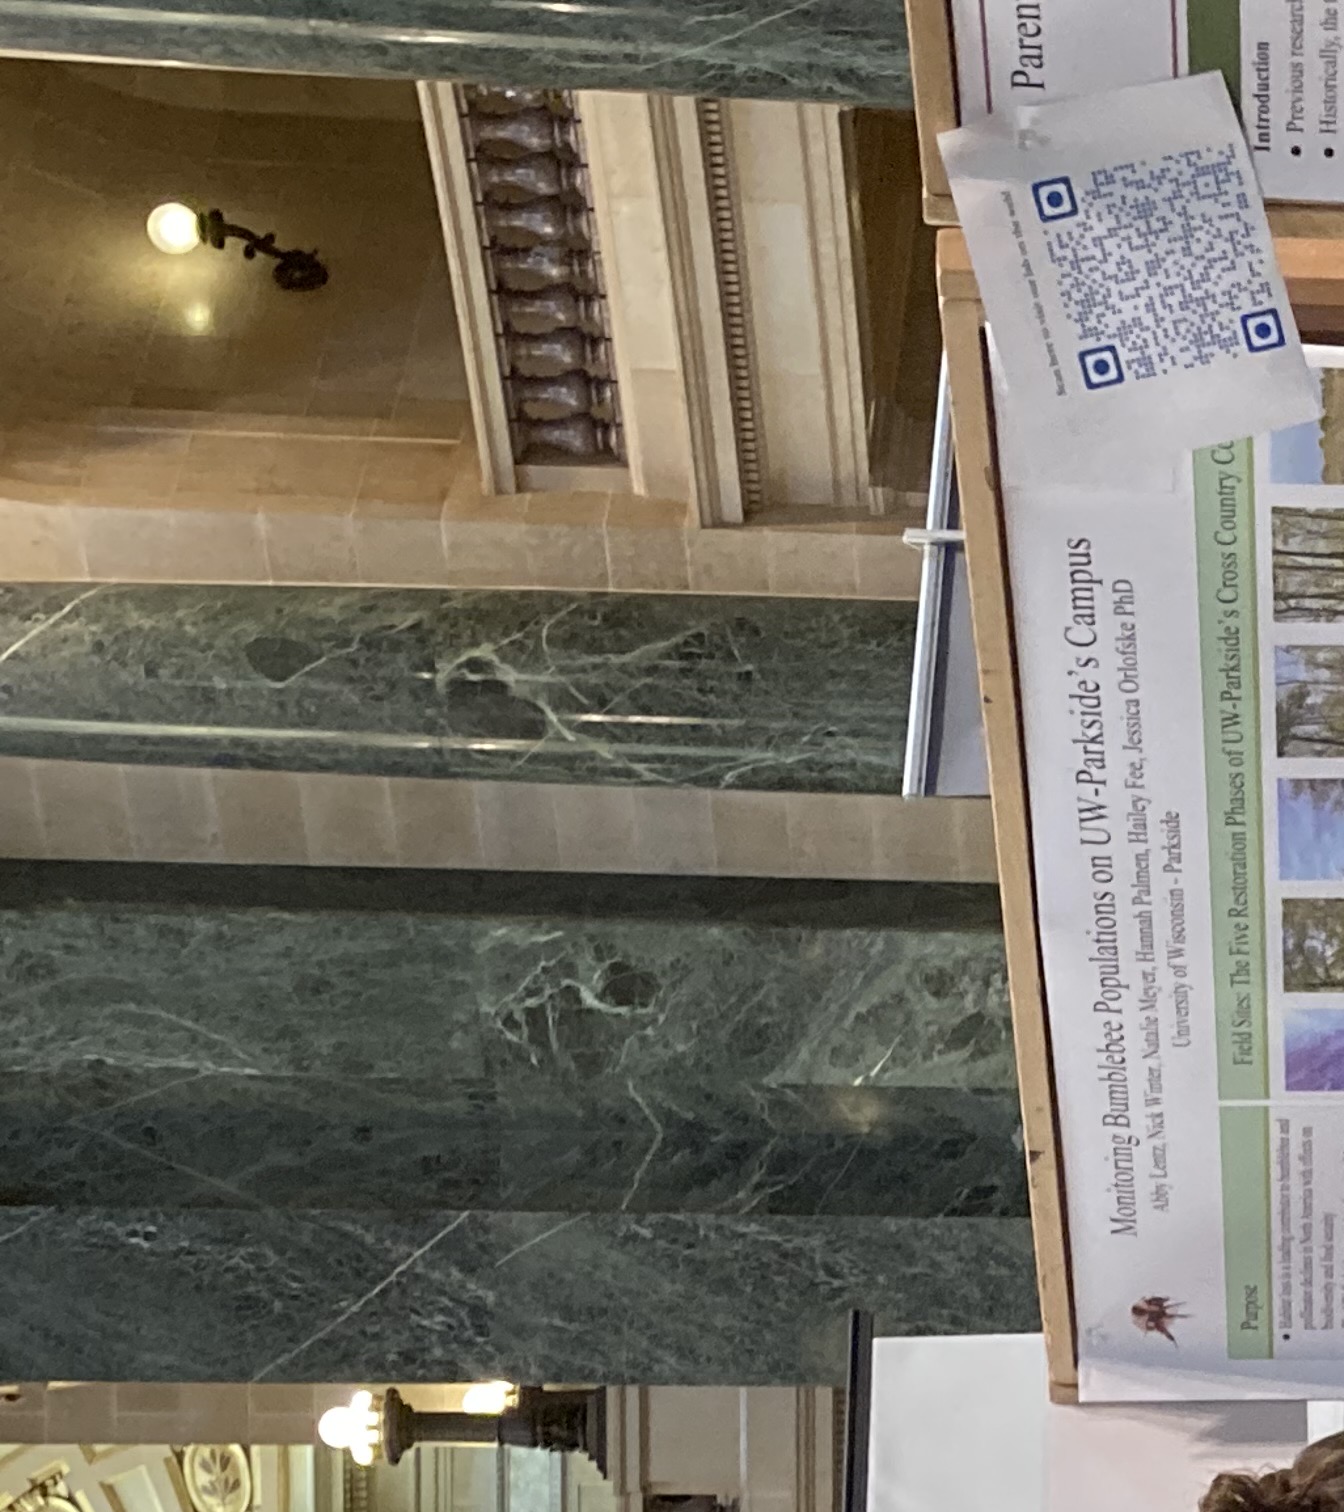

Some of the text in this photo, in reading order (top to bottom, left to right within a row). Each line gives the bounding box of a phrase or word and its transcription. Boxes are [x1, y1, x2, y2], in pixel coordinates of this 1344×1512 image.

[1010, 0, 1045, 90] Paren
[1319, 8, 1342, 134] Historically, the
[1252, 41, 1270, 152] Introduction
[1285, 62, 1304, 132] Previous
[1214, 471, 1242, 546] Country
[1063, 537, 1103, 647] Campus
[1112, 579, 1135, 616] PhD
[1216, 552, 1239, 604] Cross
[1115, 622, 1139, 694] Orlofske
[1120, 699, 1142, 753] Jessica
[1124, 758, 1147, 789] Fee,
[1222, 747, 1243, 767] of
[1125, 793, 1152, 844] Hailey
[1224, 772, 1245, 827] Phases
[1090, 855, 1114, 883] on
[1225, 831, 1249, 918] Restoration
[1086, 891, 1130, 1015] Populations
[1133, 910, 1155, 962] Hannah
[1159, 811, 1193, 1047] University of Wisconsin Parkside
[1228, 923, 1250, 955] Five
[1138, 966, 1161, 1011] Meyer,
[1229, 960, 1250, 987] The
[1139, 1016, 1160, 1060] Natalie
[1231, 1032, 1252, 1066] Field
[1095, 1021, 1131, 1128] Bumblebee
[1147, 1112, 1165, 1139] Nick
[1104, 1133, 1140, 1237] Monitoring
[1150, 1183, 1174, 1213] Abby
[1241, 1284, 1263, 1331] Purpose
